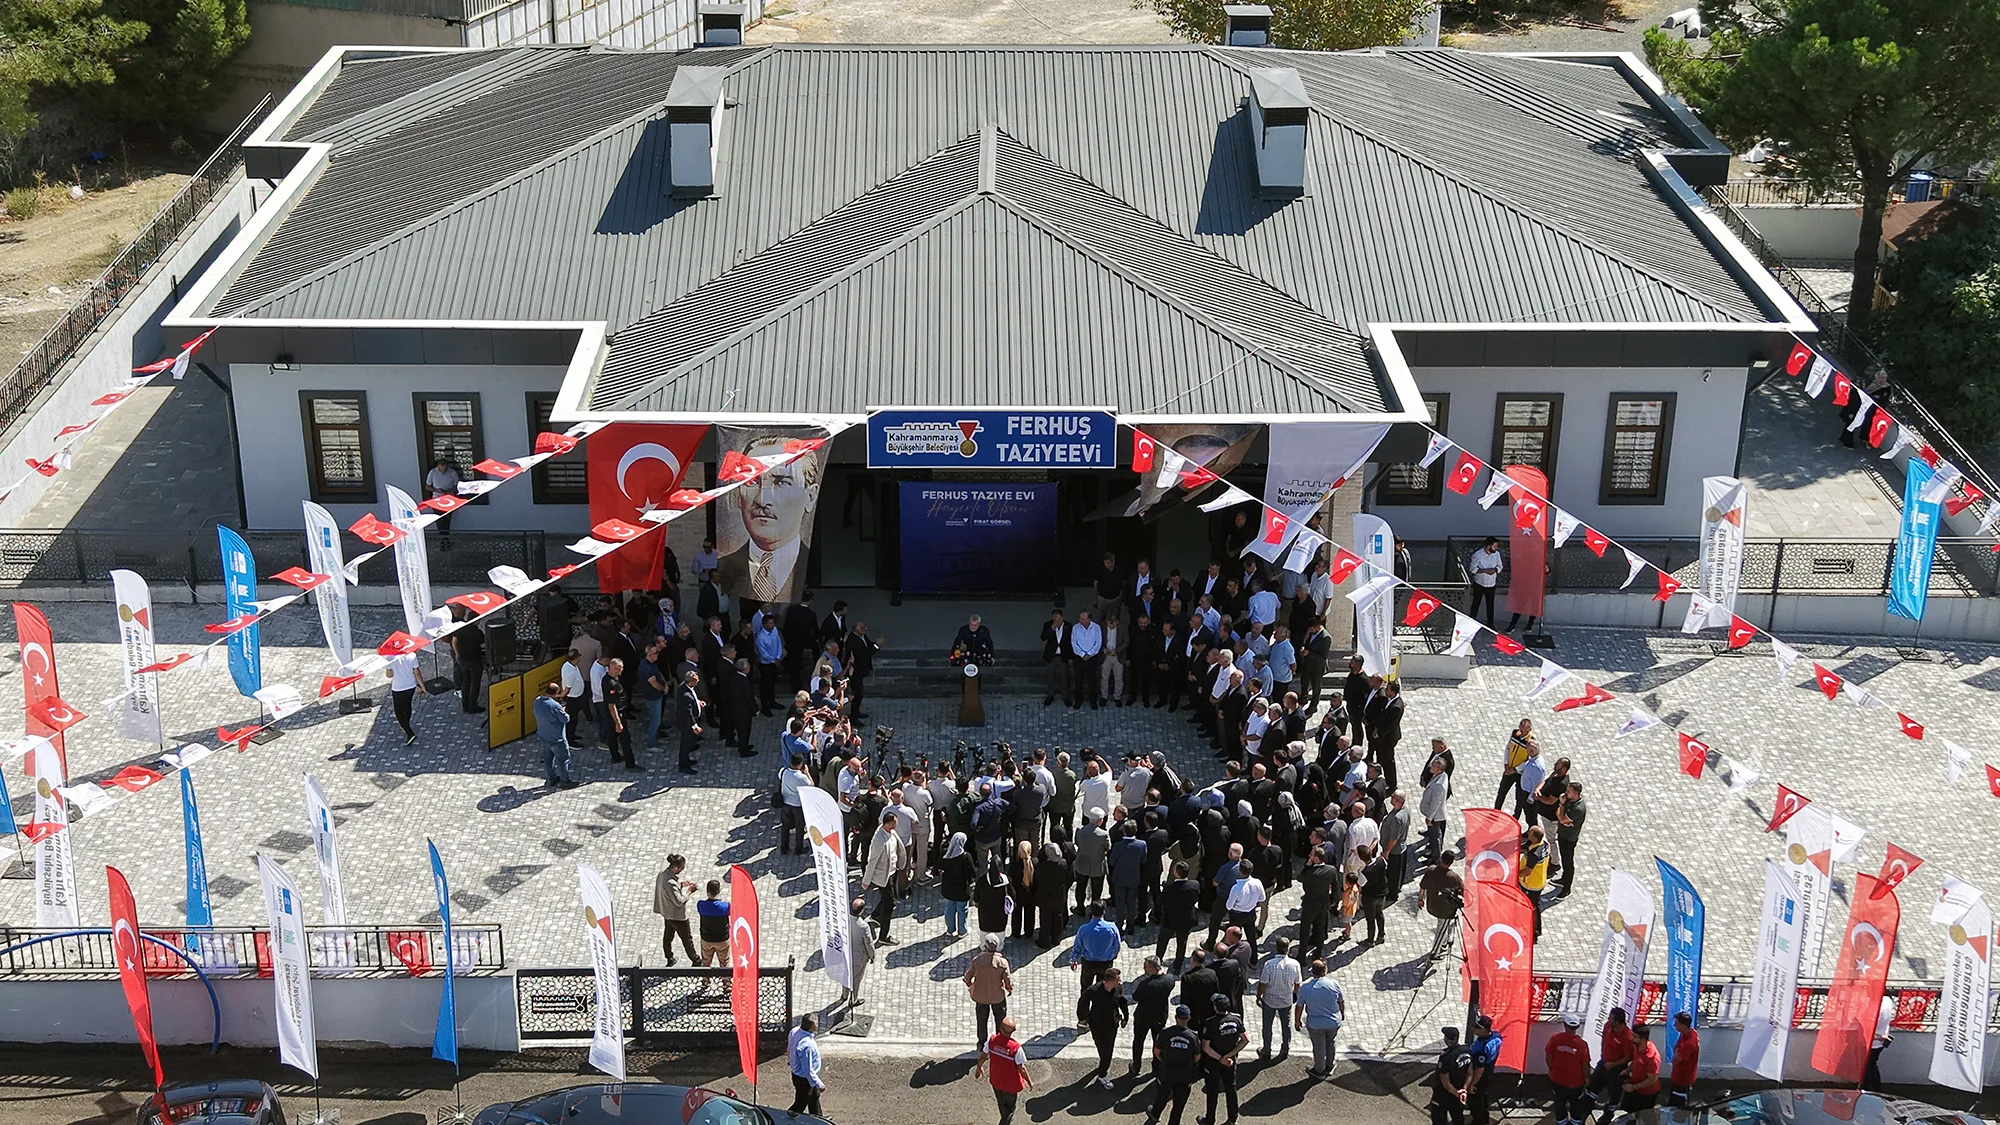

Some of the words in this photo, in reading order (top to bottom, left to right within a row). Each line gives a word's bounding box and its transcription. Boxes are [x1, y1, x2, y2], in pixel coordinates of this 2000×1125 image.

[1007, 416, 1091, 440] FERHUŞ
[889, 433, 959, 443] Kahramanmaraş
[888, 442, 925, 454] Büyükşehir
[926, 442, 959, 453] Belediyesi
[922, 490, 968, 501] FERHUŞ
